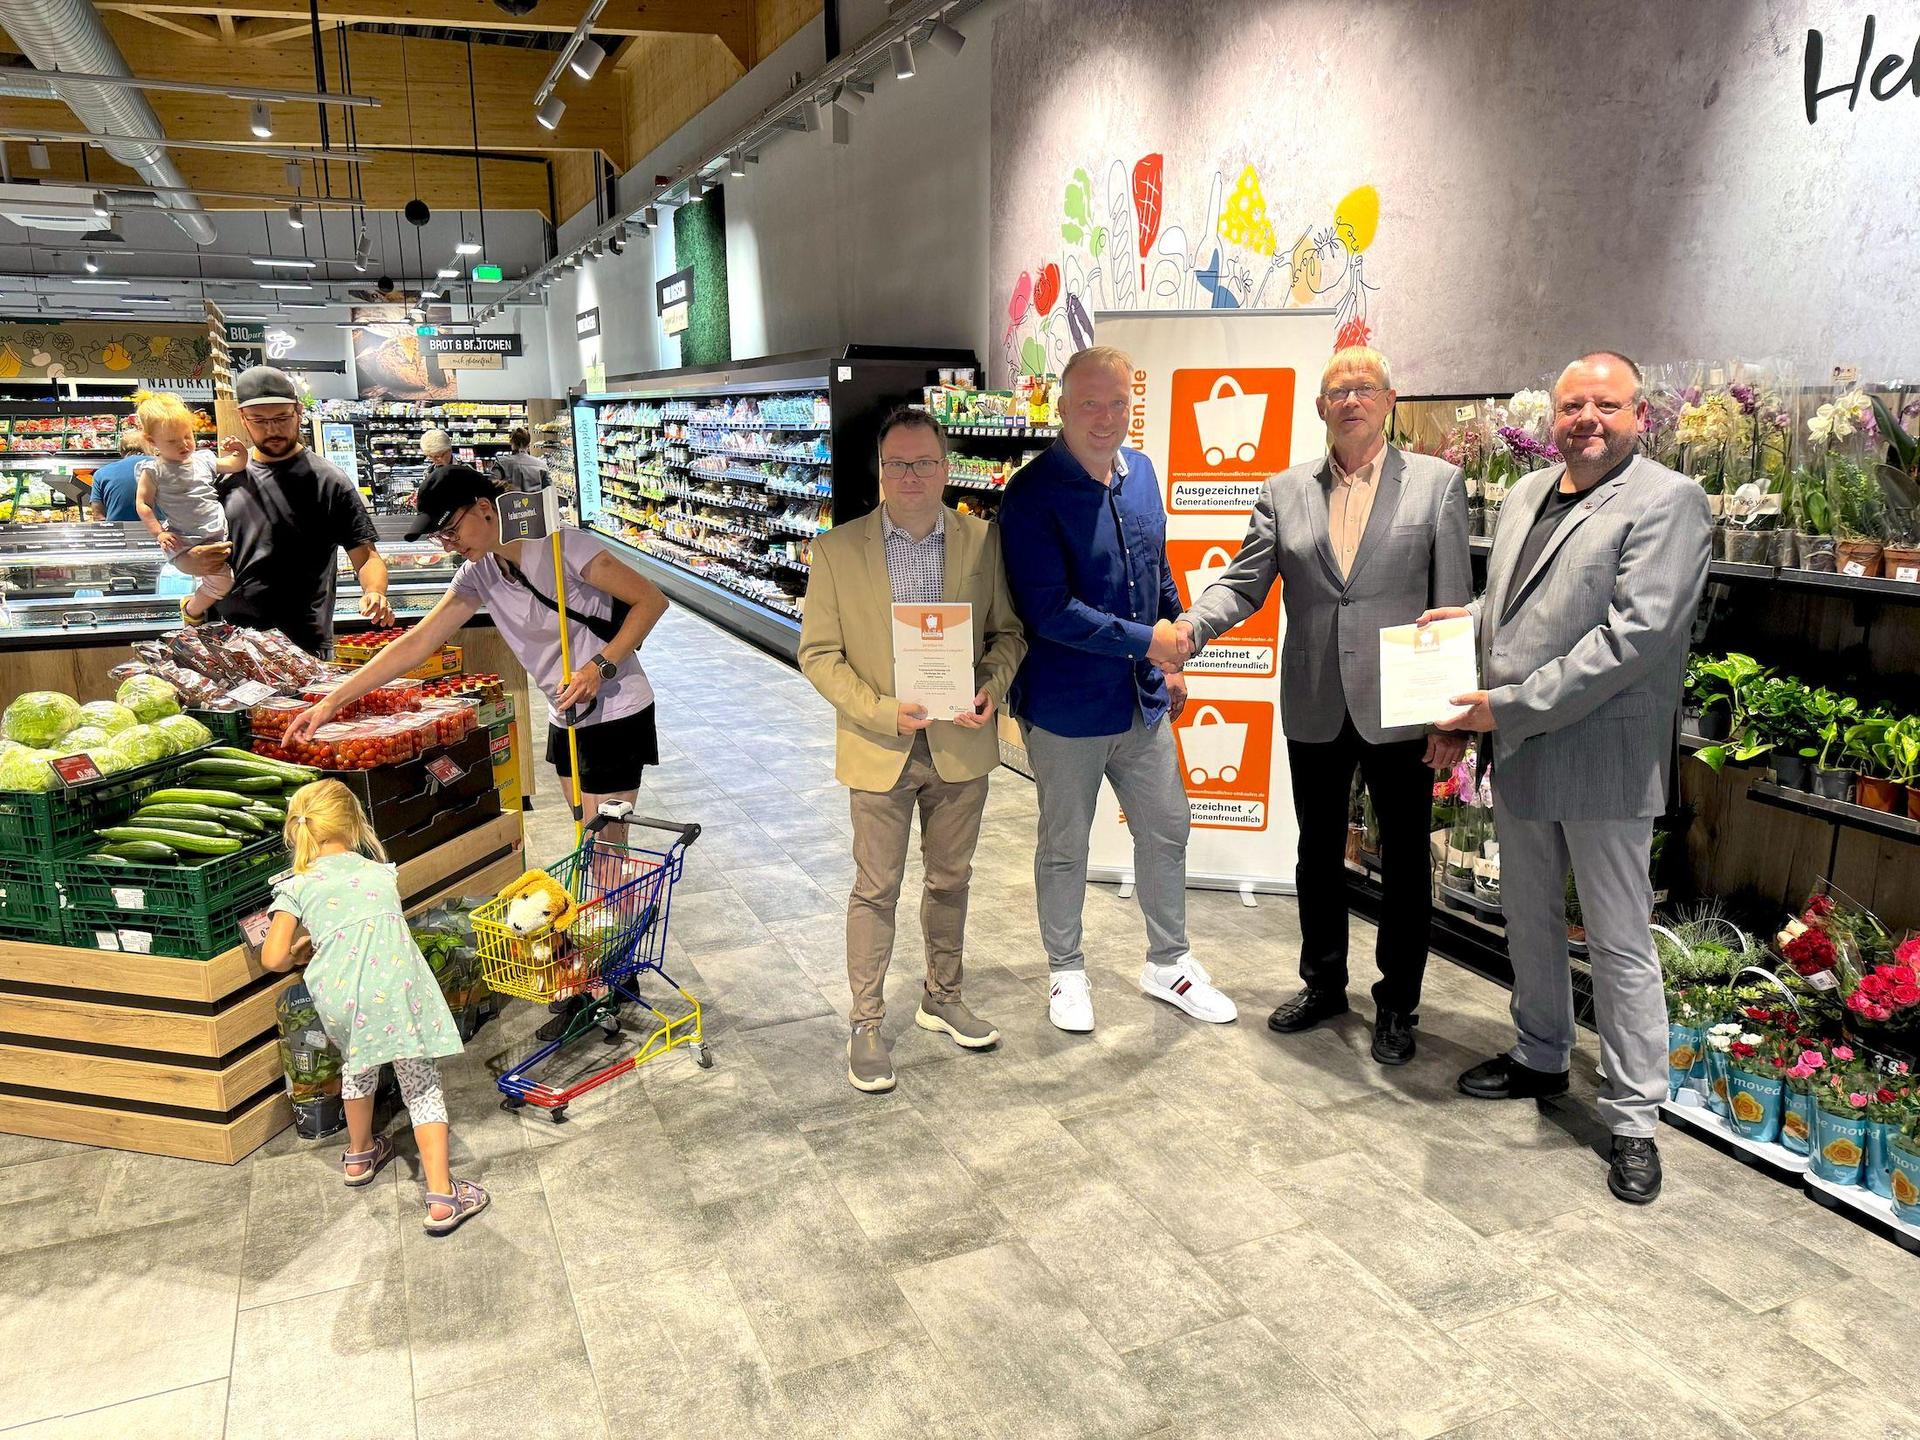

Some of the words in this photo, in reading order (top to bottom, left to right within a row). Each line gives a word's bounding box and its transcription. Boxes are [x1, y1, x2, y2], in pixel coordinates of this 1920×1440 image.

[430, 340, 453, 350] BROT
[456, 340, 462, 350] &
[1176, 485, 1259, 497] Ausgezeichnet
[1733, 1077, 1781, 1095] moved
